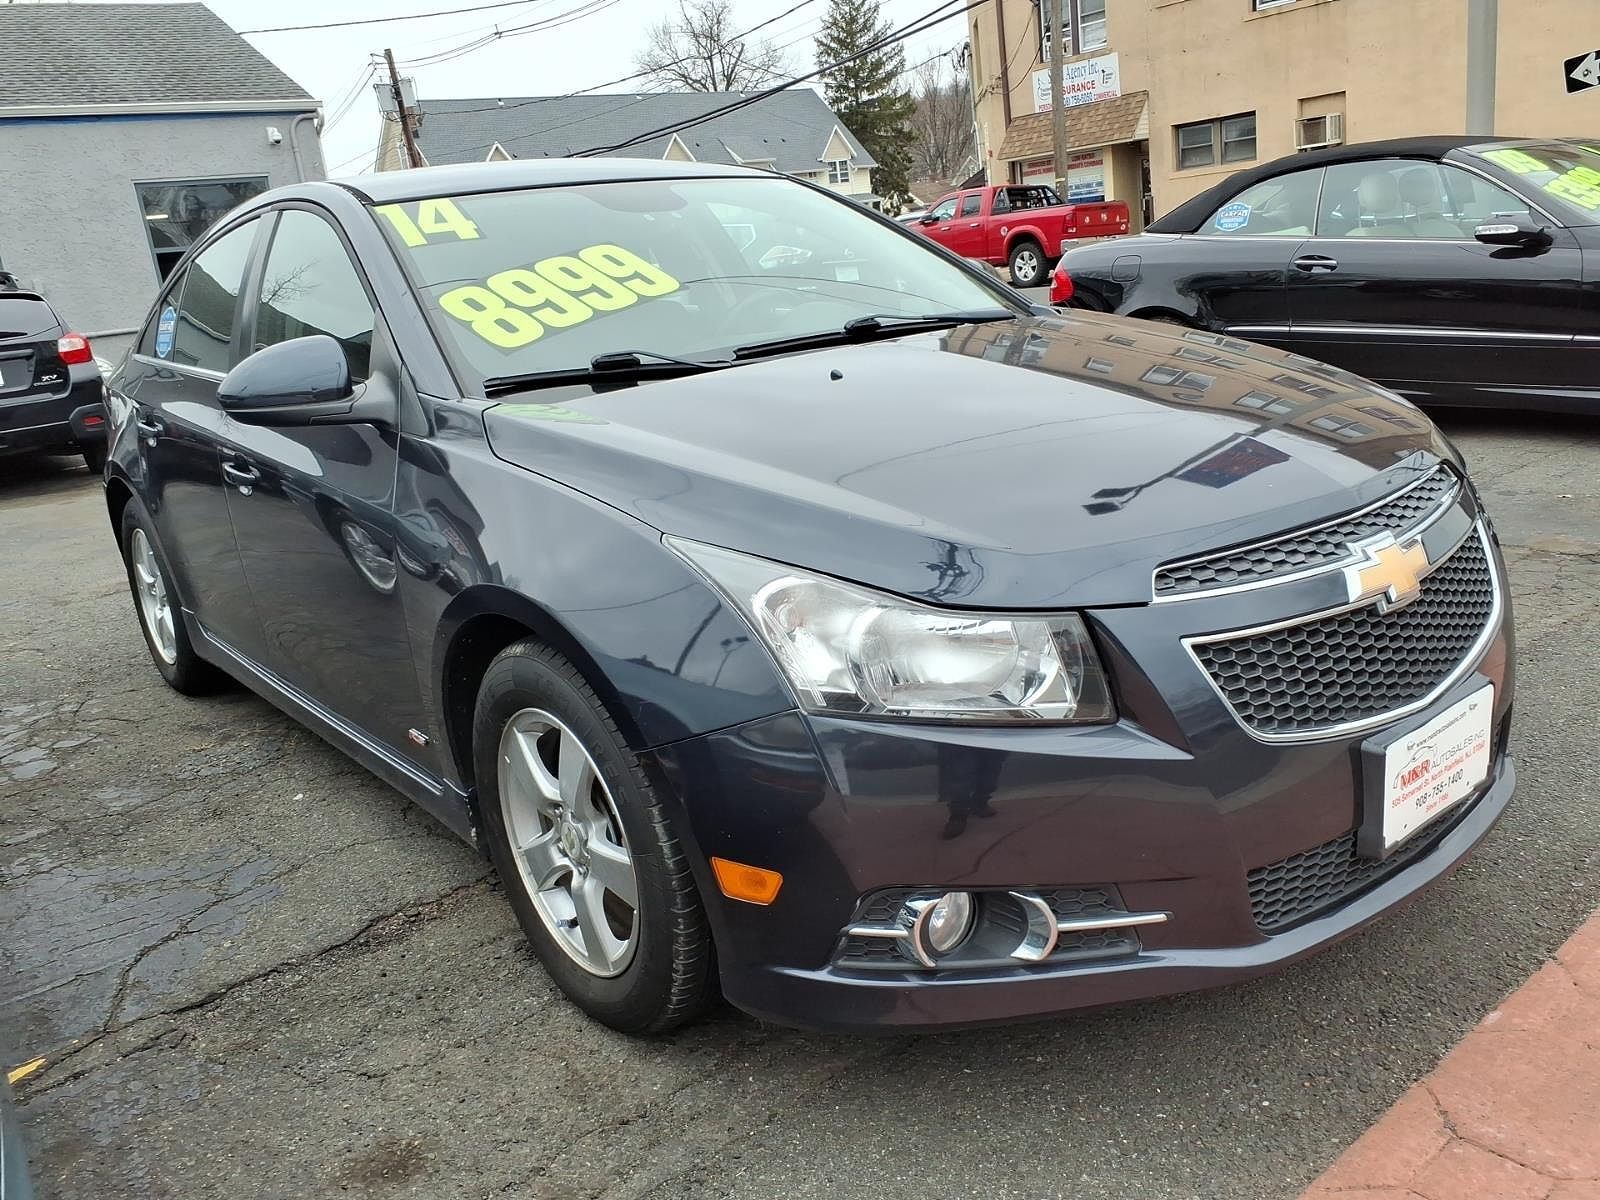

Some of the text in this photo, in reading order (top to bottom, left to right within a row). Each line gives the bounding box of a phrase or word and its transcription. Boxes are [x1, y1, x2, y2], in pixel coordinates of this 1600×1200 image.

[1063, 80, 1096, 95] SURANCE
[1066, 64, 1087, 83] Agency
[374, 197, 480, 247] 14
[438, 244, 680, 348] 8999
[1400, 759, 1431, 790] M&R
[1415, 768, 1463, 810] 908-755-1400
